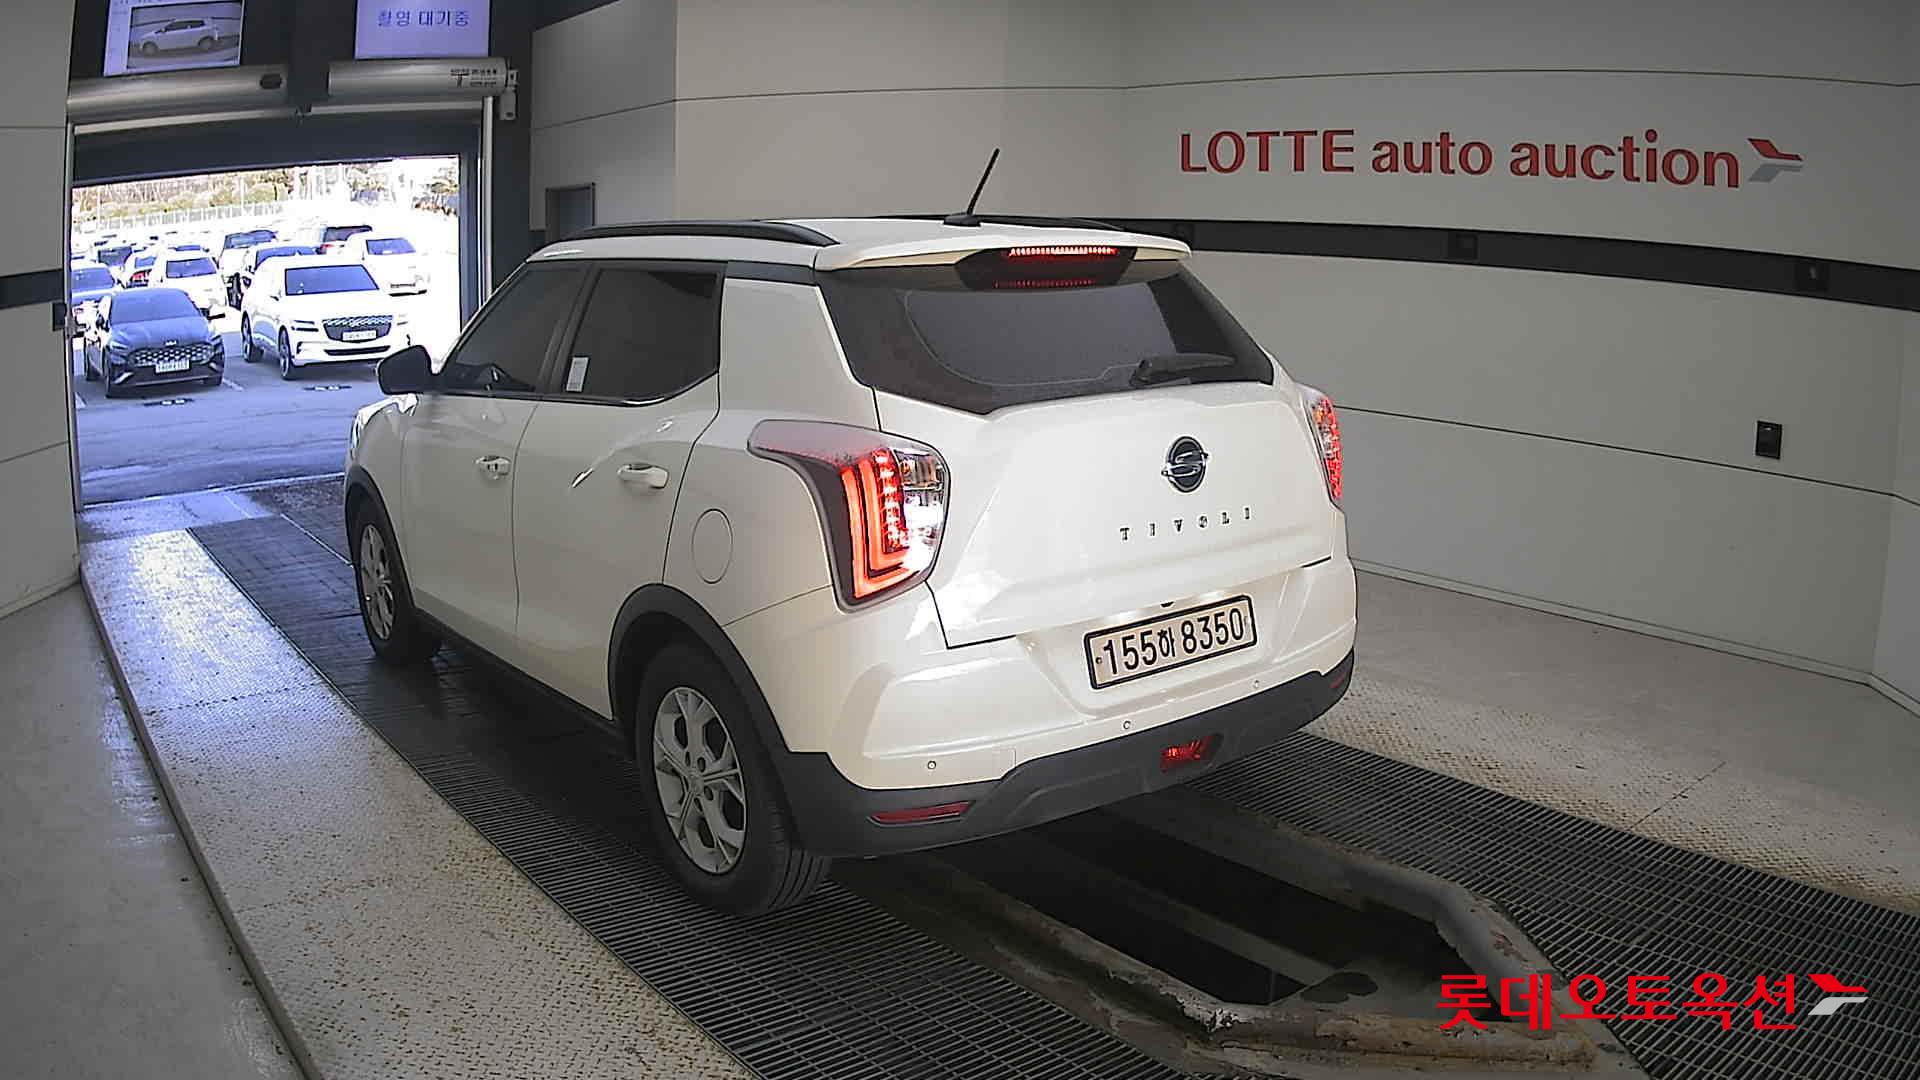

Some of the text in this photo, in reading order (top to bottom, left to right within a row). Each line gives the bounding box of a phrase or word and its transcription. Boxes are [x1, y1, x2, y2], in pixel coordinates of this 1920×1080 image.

[418, 9, 468, 27] 대기중
[1180, 129, 1740, 189] LOTTE auto auction
[1119, 506, 1252, 541] TIVOLI
[1103, 607, 1246, 675] 155하 8350
